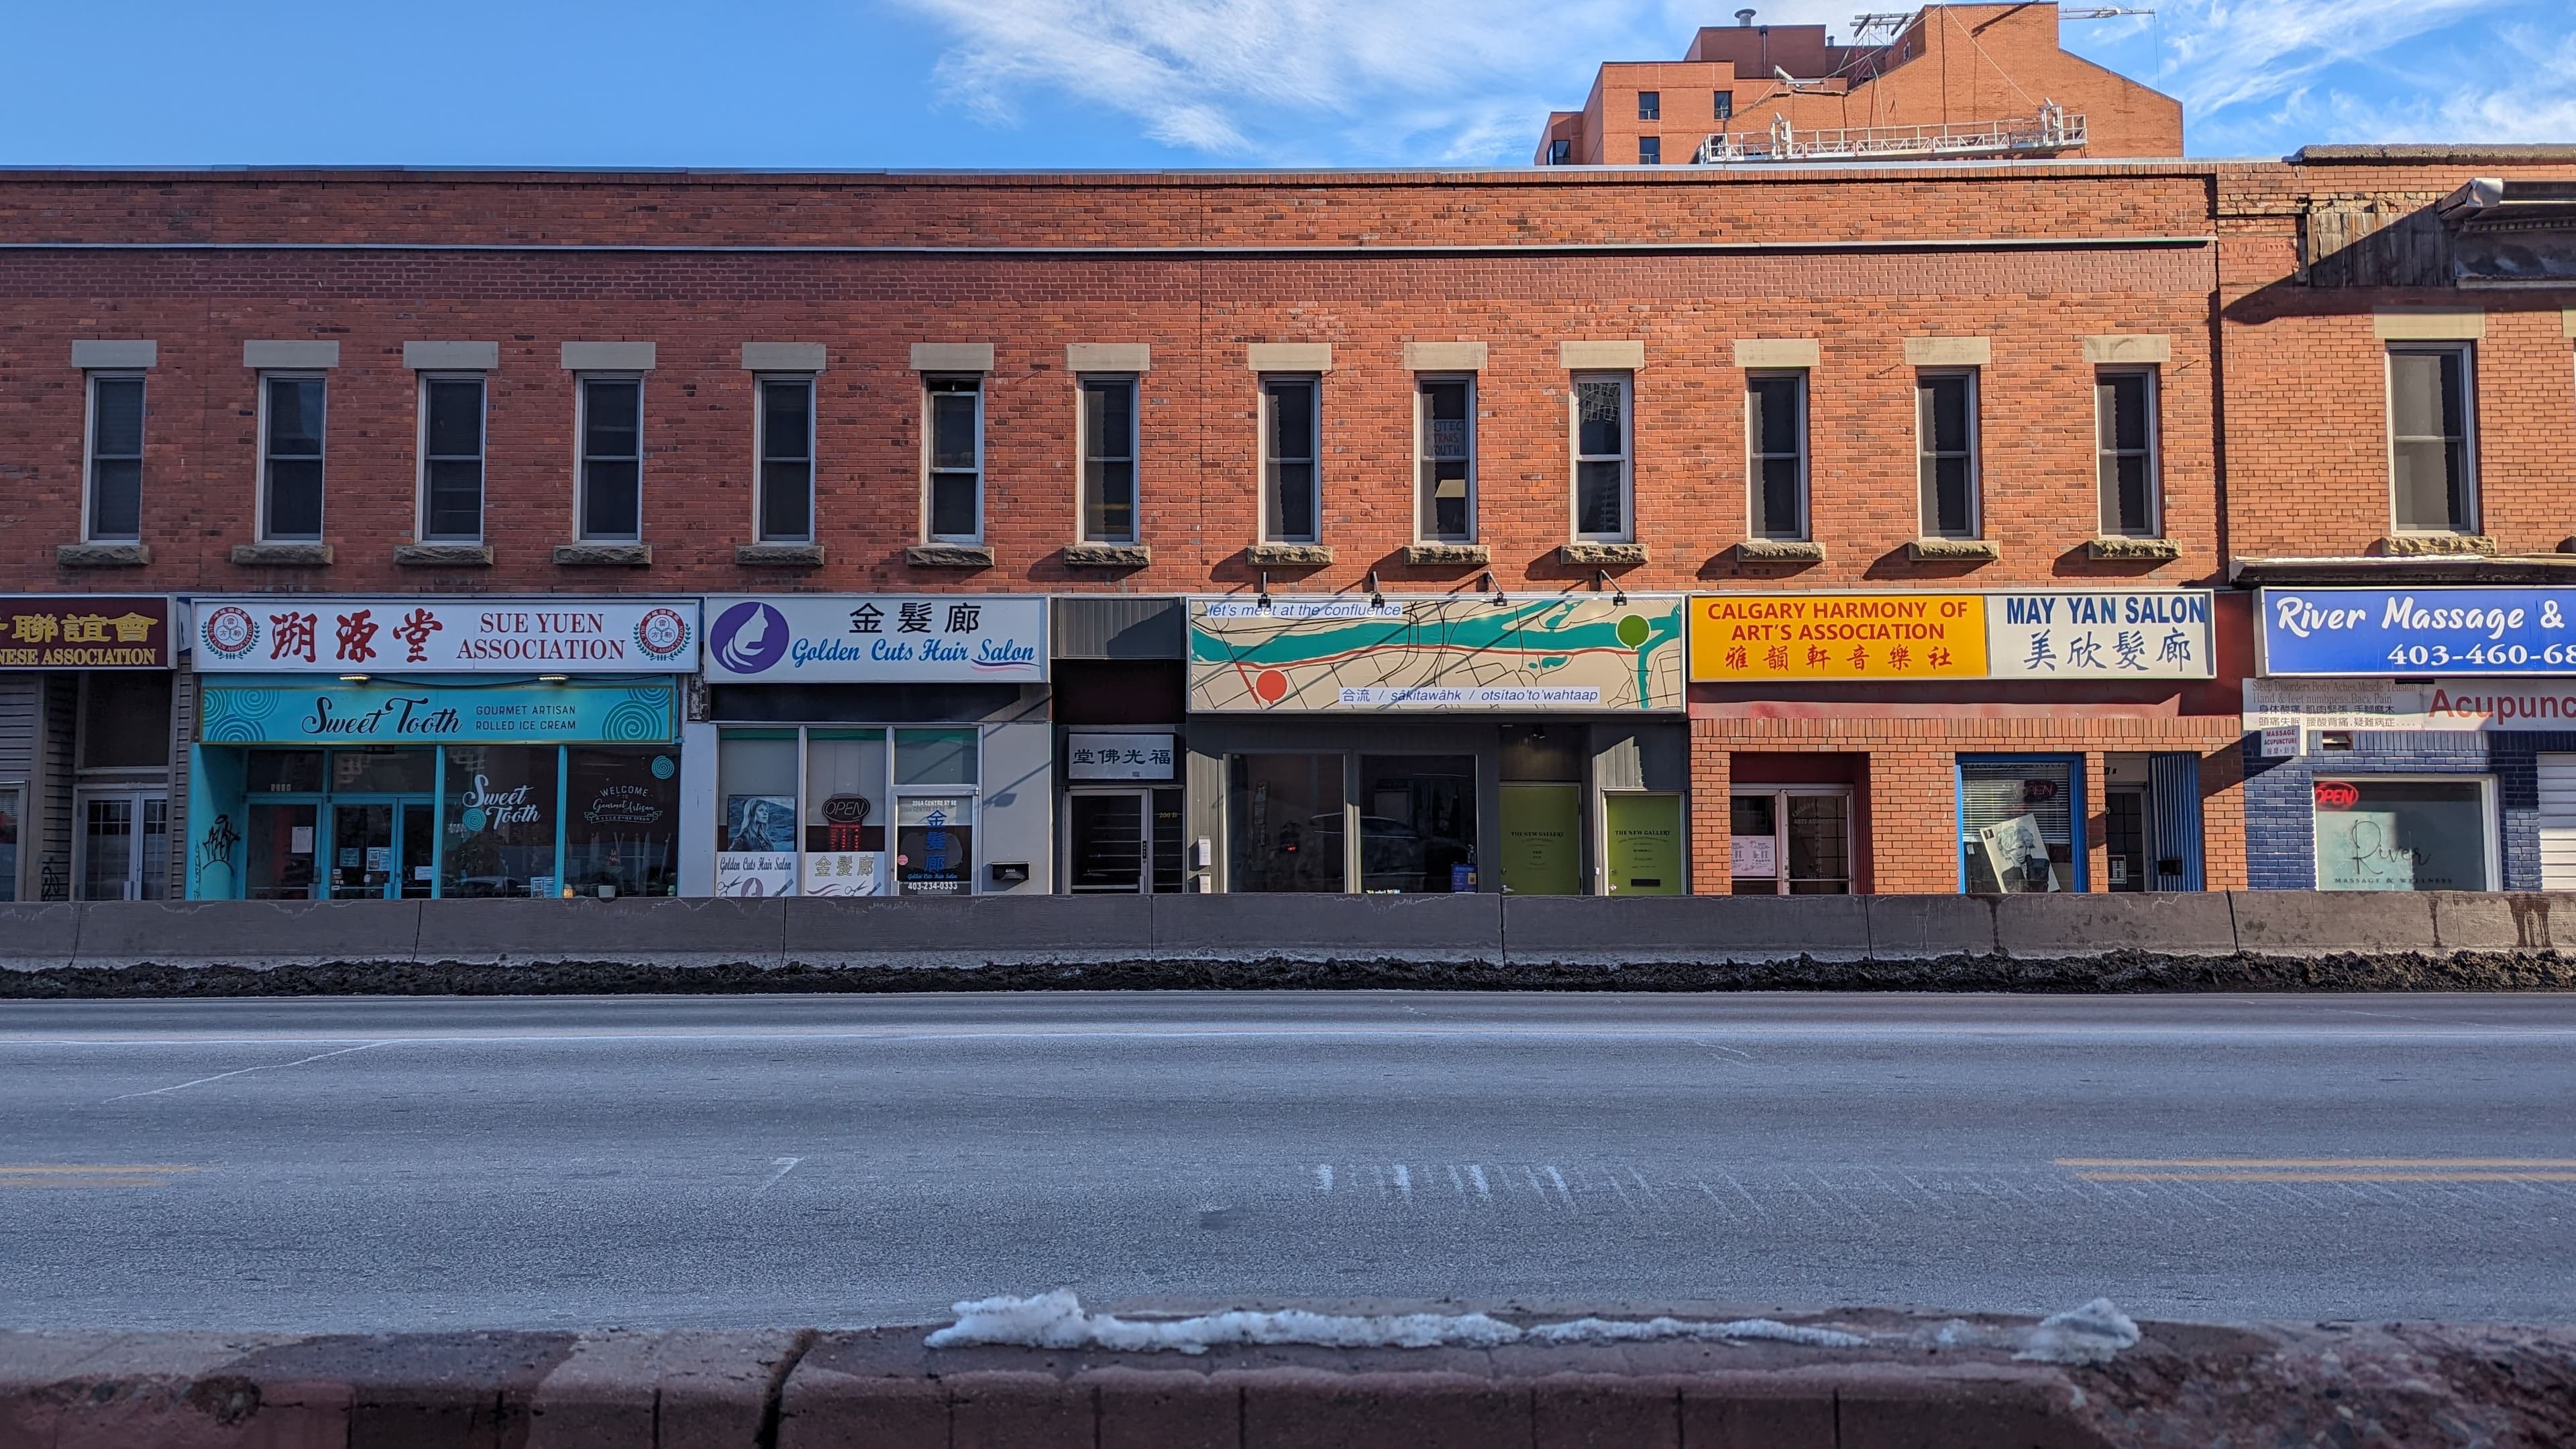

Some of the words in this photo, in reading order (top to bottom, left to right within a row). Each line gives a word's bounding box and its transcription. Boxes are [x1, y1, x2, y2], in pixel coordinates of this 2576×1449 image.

[849, 602, 982, 634] 金髮廊
[1241, 604, 1277, 616] meet
[1281, 604, 1295, 615] at
[1299, 604, 1322, 615] the
[1324, 604, 1401, 616] confluence
[1708, 602, 1807, 620] CALGARY
[1813, 602, 1927, 619] HARMONY
[1940, 601, 1968, 619] OF
[2006, 597, 2056, 625] MAY
[2066, 596, 2116, 624] YAN
[2125, 596, 2206, 624] SALON
[2276, 596, 2365, 638] River
[2381, 596, 2524, 640] Massage
[2540, 600, 2565, 629] &
[0, 612, 158, 643] 聯誼會
[480, 612, 529, 633] SUE
[535, 612, 604, 633] YUEN
[1799, 623, 1945, 641] ASSOCIATION
[41, 648, 156, 665] ASSOCIATION
[457, 639, 626, 660] ASSOCIATION
[792, 638, 861, 668] Golden
[871, 638, 914, 661] Cuts
[918, 638, 969, 661] Hair
[977, 638, 1035, 661] Salon
[2023, 627, 2192, 672] 美欣髮廊
[1342, 689, 1371, 702] 合流
[2252, 680, 2273, 692] Sleep
[2386, 682, 2416, 692] Tension
[2253, 693, 2275, 704] Hand
[2278, 693, 2285, 704] &
[2288, 693, 2304, 704] feet
[2374, 692, 2392, 704] Pain
[2428, 689, 2576, 725] Acupunc
[301, 696, 391, 734] Sweet
[384, 697, 464, 734] Tooth
[476, 706, 527, 716] GOURMET
[532, 706, 576, 716] ARTISAN
[476, 720, 515, 731] ROLLED
[519, 720, 536, 731] ICE
[540, 719, 576, 731] CREAM
[462, 774, 535, 808] Sweet
[600, 786, 649, 797] WELCOME
[2315, 788, 2356, 804] OPEN
[593, 798, 627, 813] Gourmet
[623, 801, 655, 813] Artisan
[824, 801, 865, 816] OPEN
[485, 804, 541, 830] Tooth
[2352, 820, 2431, 875] River
[720, 857, 740, 875] Golden
[743, 857, 755, 870] Cuts
[757, 857, 772, 870] Hair
[774, 857, 792, 871] Salon
[814, 855, 875, 877] 金髮廊
[908, 881, 958, 890] 403-234-0333
